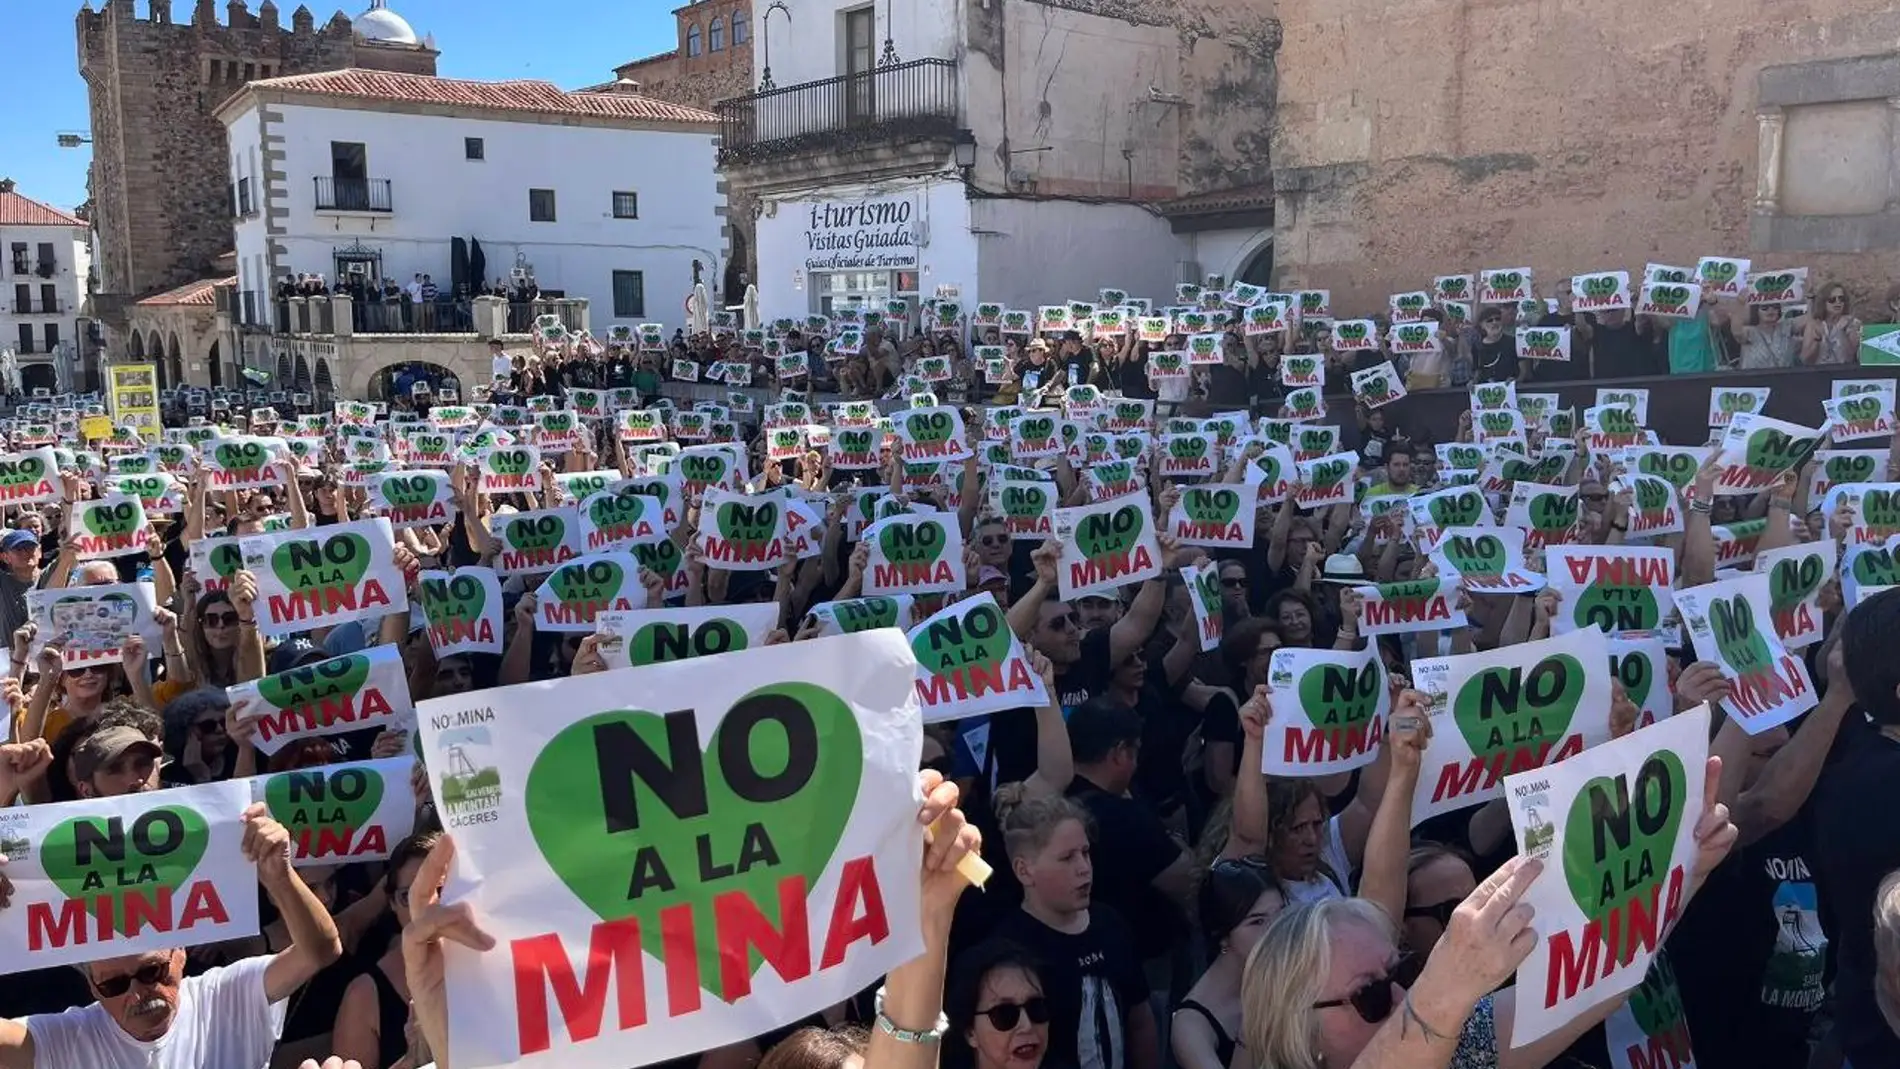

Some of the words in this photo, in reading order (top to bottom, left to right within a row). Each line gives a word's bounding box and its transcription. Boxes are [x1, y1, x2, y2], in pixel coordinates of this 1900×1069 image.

[811, 200, 910, 229] i-turismo
[804, 231, 852, 250] Visitas
[864, 254, 875, 267] de
[877, 254, 915, 267] Turismo
[1706, 262, 1732, 274] NO
[1445, 278, 1462, 287] NO
[1495, 273, 1518, 283] NO
[1588, 276, 1613, 288] NO
[1763, 274, 1792, 285] NO
[1402, 296, 1420, 305] NO
[1486, 289, 1525, 299] MINA
[1579, 294, 1623, 307] MINA
[1655, 286, 1685, 298] NO
[1751, 290, 1794, 302] MINA
[1254, 306, 1272, 318] NO
[1642, 303, 1690, 315] MINA
[1247, 320, 1282, 332] MINA
[1345, 323, 1362, 335] NO
[1403, 326, 1425, 338] NO
[1193, 338, 1210, 348] NO
[1336, 338, 1371, 348] MINA
[1397, 341, 1434, 350] MINA
[1532, 332, 1554, 342] NO
[1522, 349, 1564, 358] MINA
[1121, 403, 1141, 413] NO
[1726, 393, 1750, 405] NO
[1846, 399, 1874, 412] NO
[353, 405, 368, 413] NO
[632, 412, 651, 423] NO
[310, 417, 327, 425] NO
[544, 415, 567, 425] NO
[916, 412, 946, 429] NO
[1026, 420, 1049, 433] NO
[1110, 418, 1146, 428] MINA
[1839, 419, 1888, 437] MINA
[192, 429, 209, 438] NO
[422, 436, 443, 446] NO
[541, 430, 577, 441] MINA
[623, 428, 658, 437] MINA
[846, 432, 868, 445] NO
[1307, 431, 1330, 444] NO
[160, 447, 180, 456] NO
[225, 442, 260, 458] NO
[358, 441, 372, 449] NO
[904, 440, 963, 458] MINA
[1017, 440, 1058, 453] MINA
[1175, 437, 1202, 450] NO
[1762, 431, 1817, 457] NO
[0, 457, 37, 475] NO
[124, 457, 145, 466] NO
[412, 453, 450, 463] MINA
[497, 450, 530, 465] NO
[690, 457, 719, 472] NO
[833, 453, 877, 465] MINA
[1166, 457, 1210, 471] MINA
[1651, 453, 1688, 471] NO
[1836, 457, 1867, 471] NO
[214, 466, 277, 485] MINA
[1318, 459, 1343, 476] NO
[128, 477, 158, 491] NO
[392, 475, 428, 493] NO
[485, 475, 535, 488] MINA
[576, 476, 604, 490] NO
[1639, 481, 1662, 497] NO
[1010, 488, 1040, 504] NO
[1192, 489, 1231, 508] NO
[1300, 483, 1345, 501] MINA
[597, 495, 636, 512] NO
[1441, 493, 1475, 513] NO
[94, 503, 133, 524] NO
[381, 502, 445, 523] MINA
[731, 502, 774, 526] NO
[1634, 508, 1674, 530] MINA
[517, 516, 556, 537] NO
[1005, 517, 1050, 532] MINA
[1089, 508, 1135, 540] NO
[1177, 520, 1243, 541] MINA
[82, 530, 149, 553] MINA
[588, 521, 653, 550] MINA
[892, 522, 936, 546] NO
[223, 544, 241, 565] N
[290, 535, 356, 570] NO
[638, 541, 673, 564] NO
[705, 535, 782, 563] MINA
[1455, 535, 1496, 558] NO
[503, 545, 575, 570] MINA
[1071, 545, 1152, 588] MINA
[300, 573, 313, 587] A
[319, 568, 345, 583] LA
[563, 563, 612, 585] NO
[874, 560, 955, 587] MINA
[1565, 555, 1668, 587] MINA
[1783, 557, 1815, 592] NO
[424, 578, 475, 599] NO
[663, 570, 689, 592] NA
[269, 579, 390, 624] MINA
[544, 597, 632, 624] MINA
[844, 600, 888, 619] NO
[1366, 596, 1450, 626] MINA
[1586, 604, 1643, 634] NO
[929, 605, 998, 650] NO
[1716, 598, 1748, 643] NO
[1777, 603, 1815, 639] NA
[653, 621, 730, 661] NO
[940, 653, 955, 668] A
[960, 644, 989, 663] LA
[280, 652, 353, 690] NO
[915, 657, 1035, 706] MINA
[1322, 659, 1376, 703] NO
[1479, 659, 1567, 721] NO
[1727, 655, 1807, 718] MINA
[291, 689, 305, 704] A
[312, 684, 340, 701] LA
[257, 687, 395, 742] MINA
[431, 714, 450, 731] NO
[457, 706, 495, 726] MINA
[1324, 708, 1338, 724] A
[1346, 705, 1365, 722] LA
[1283, 715, 1382, 763] MINA
[1486, 727, 1502, 751] A
[1511, 717, 1544, 742] LA
[593, 693, 818, 833] NO
[287, 766, 368, 802] NO
[292, 809, 308, 823] A
[319, 806, 346, 823] LA
[1589, 750, 1671, 863] NO
[74, 809, 185, 865] NO
[296, 824, 388, 859] INA
[627, 845, 675, 900] A
[696, 823, 780, 883] LA
[81, 870, 106, 890] A
[116, 863, 158, 886] LA
[1599, 872, 1616, 907] A
[1622, 855, 1654, 892] LA
[26, 880, 230, 951] MINA
[1544, 865, 1684, 1009] MINA
[511, 855, 890, 1055] MINA
